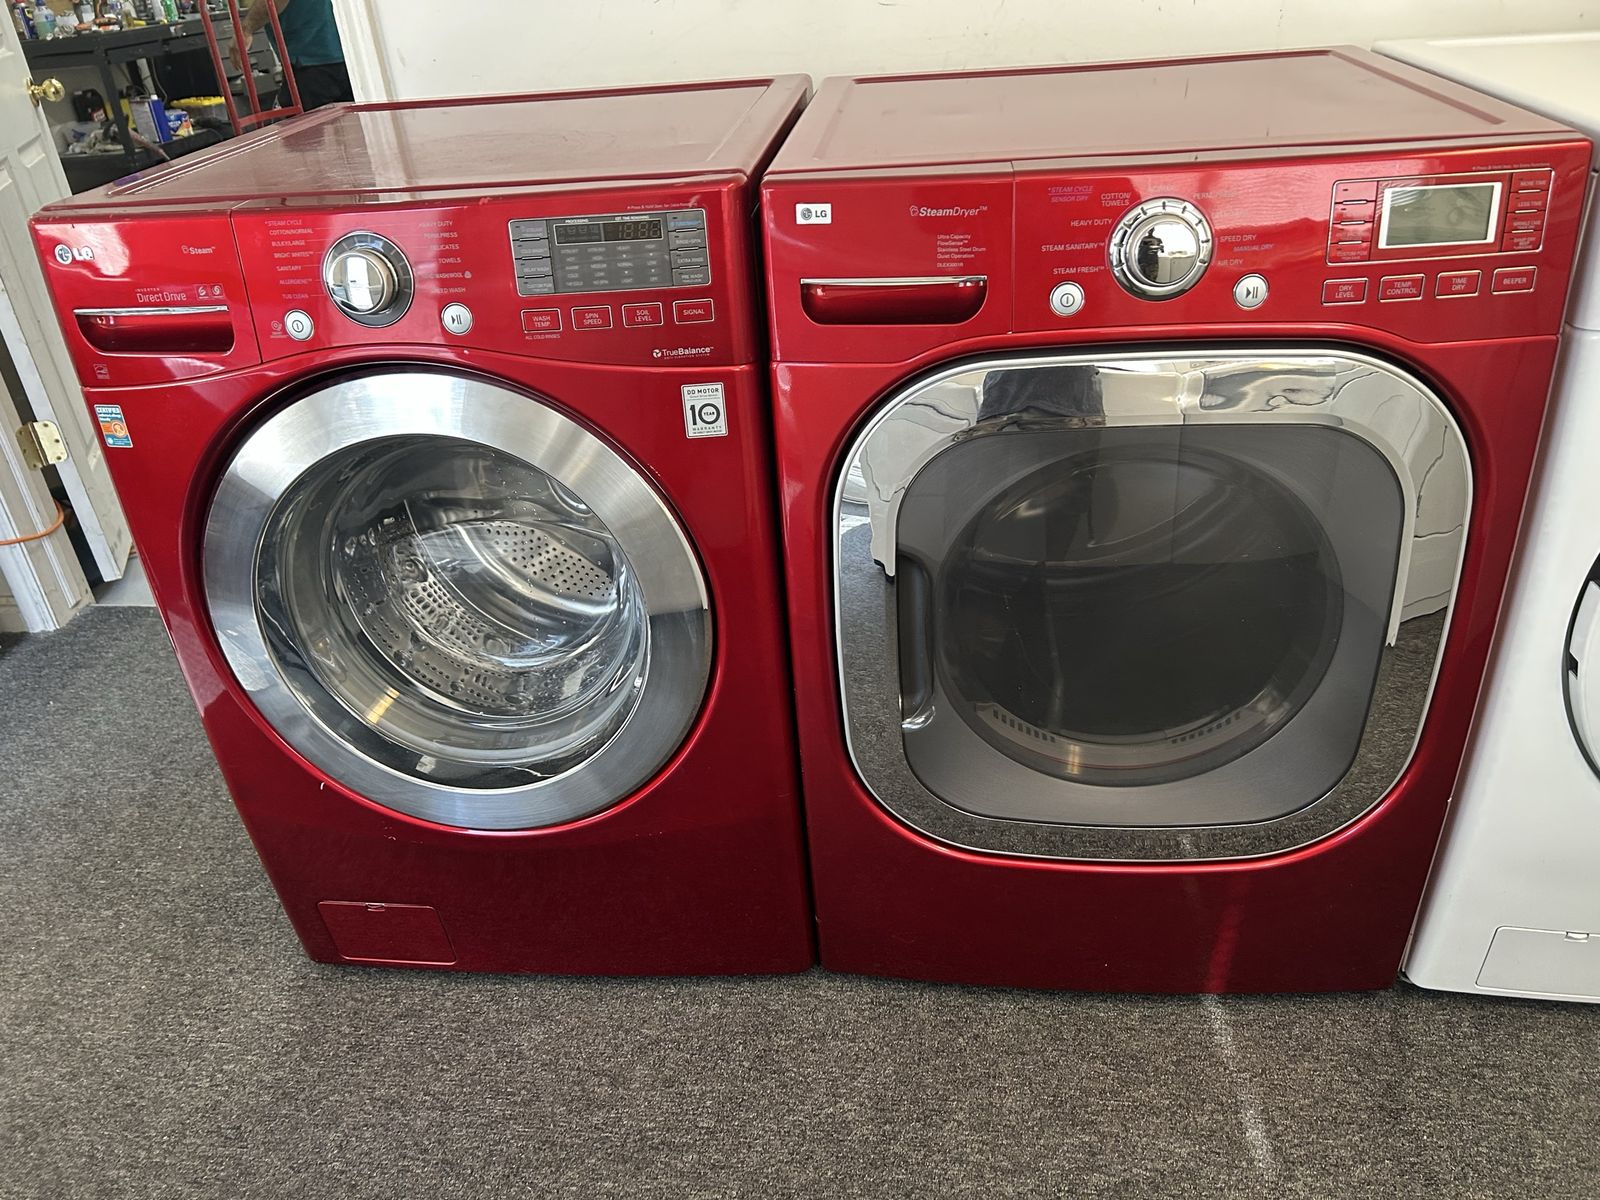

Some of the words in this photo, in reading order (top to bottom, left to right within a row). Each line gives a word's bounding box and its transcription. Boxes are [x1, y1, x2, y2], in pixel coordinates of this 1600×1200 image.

[815, 210, 827, 218] LG
[74, 247, 94, 261] LG
[1053, 267, 1077, 275] STEAM
[1502, 277, 1527, 285] BEEPER
[1387, 287, 1417, 295] CONTROL
[136, 293, 164, 303] Direct
[164, 291, 187, 302] Drive
[683, 308, 705, 316] SIGNAL
[690, 403, 721, 425] 10
